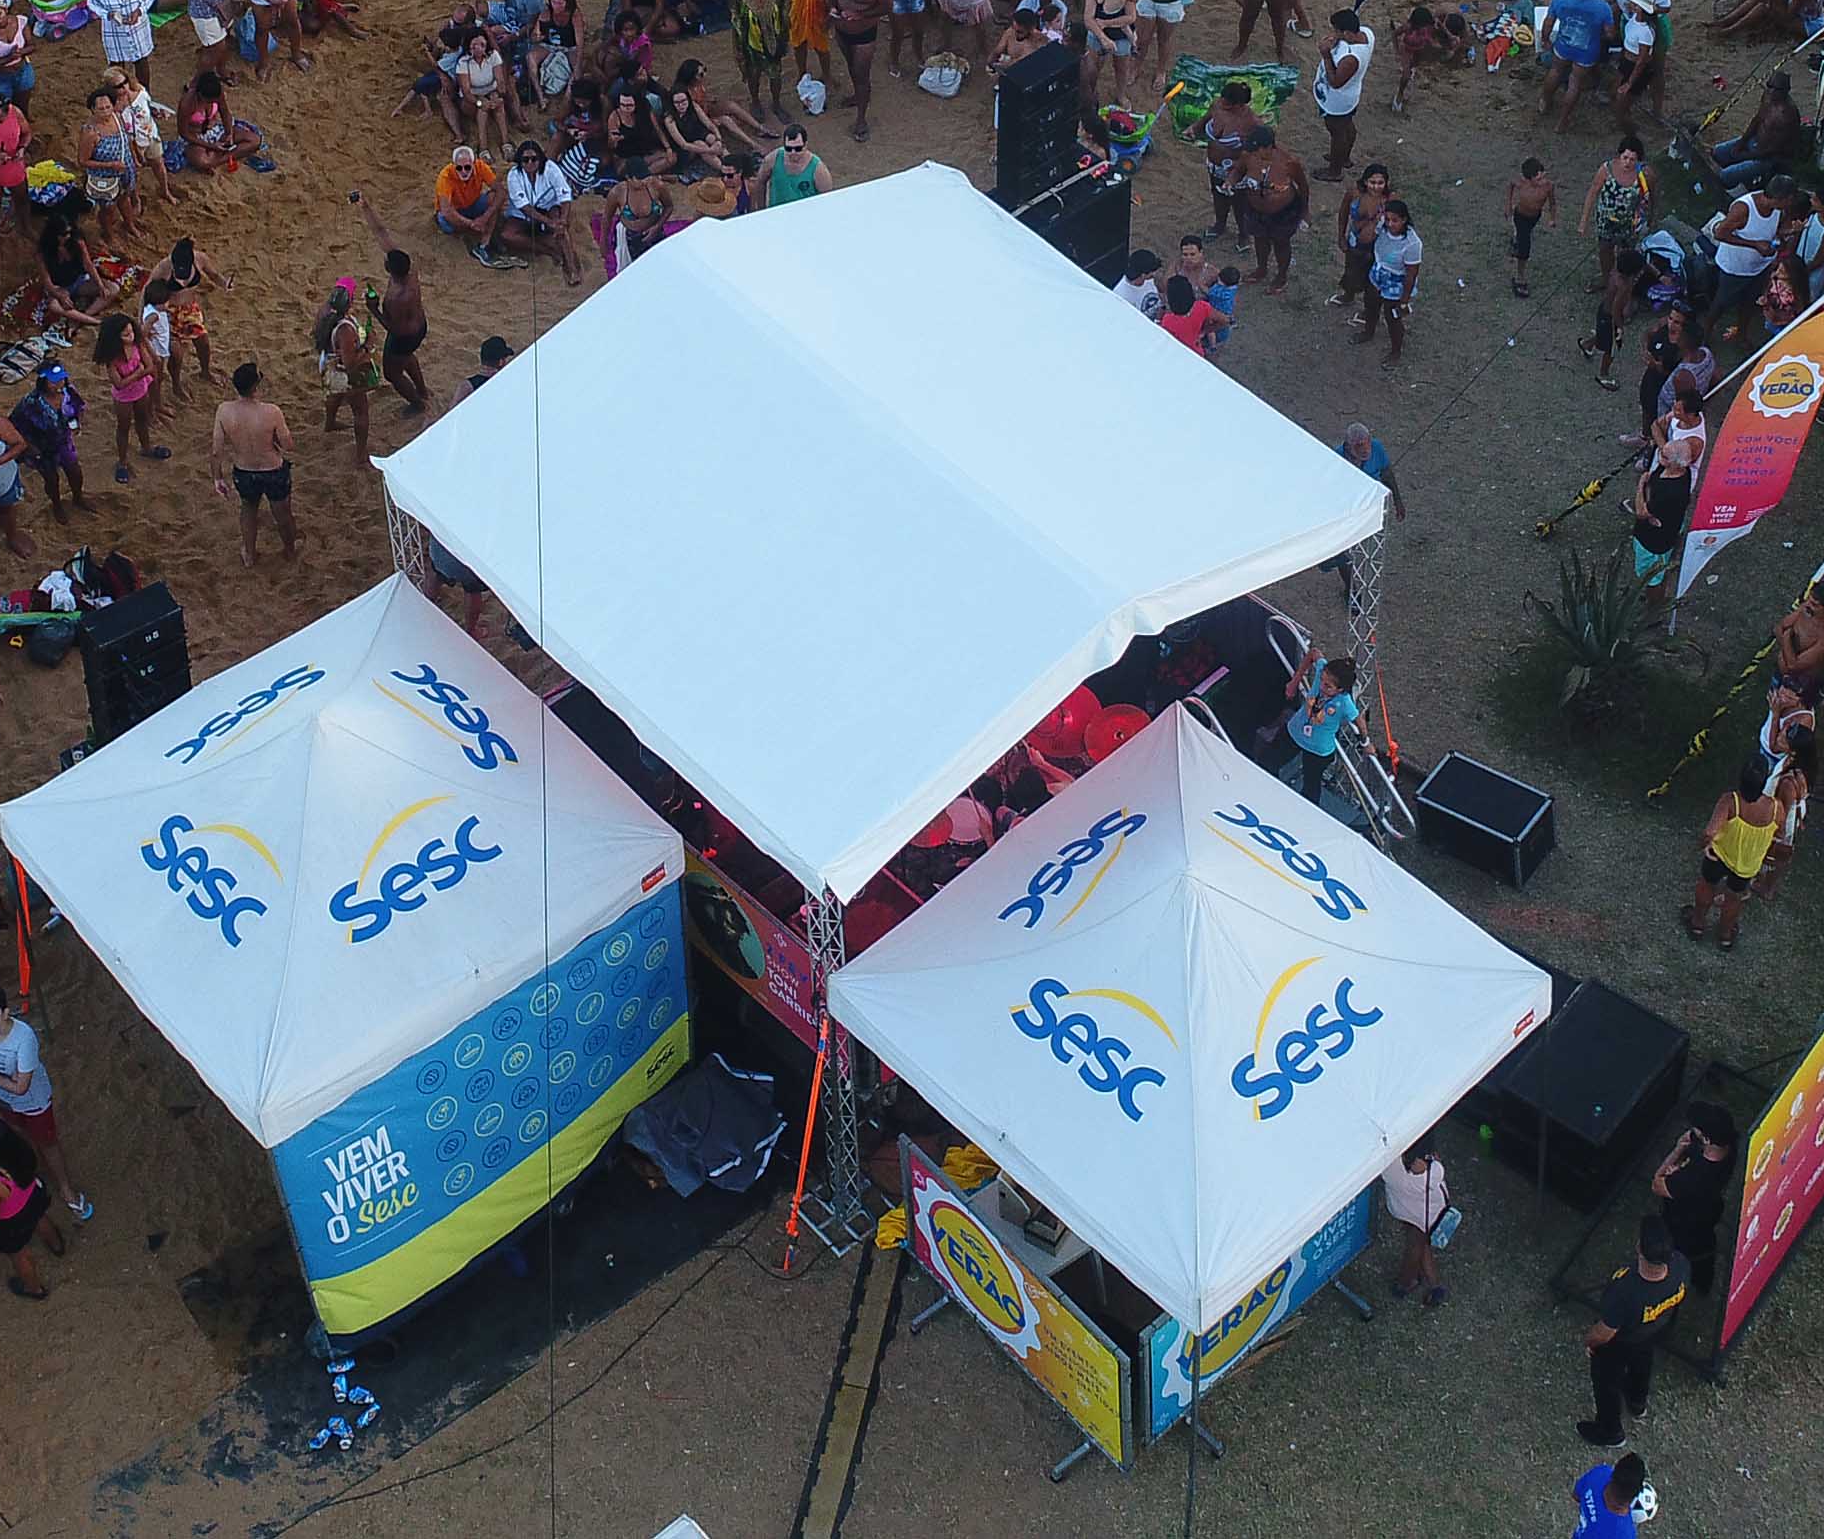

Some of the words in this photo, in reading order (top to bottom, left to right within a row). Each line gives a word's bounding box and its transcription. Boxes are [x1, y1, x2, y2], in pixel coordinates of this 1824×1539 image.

[1758, 380, 1814, 397] VERÃO
[164, 664, 326, 765] Sesc
[391, 662, 518, 771] Sesc
[141, 815, 267, 948] Sesc
[329, 815, 503, 944] Sesc
[999, 807, 1147, 930] Sesc
[1213, 803, 1369, 922] Sesc
[767, 969, 798, 999] TONI
[768, 983, 821, 1029] GARRI
[1010, 977, 1166, 1123] Sesc
[1231, 977, 1384, 1122] Sesc
[320, 1149, 409, 1217] VIVER
[325, 1124, 393, 1181] VEM
[325, 1213, 352, 1245] O
[355, 1182, 420, 1236] Sesc
[931, 1226, 1026, 1329] VERÃO
[1585, 1488, 1597, 1523] STAFF
